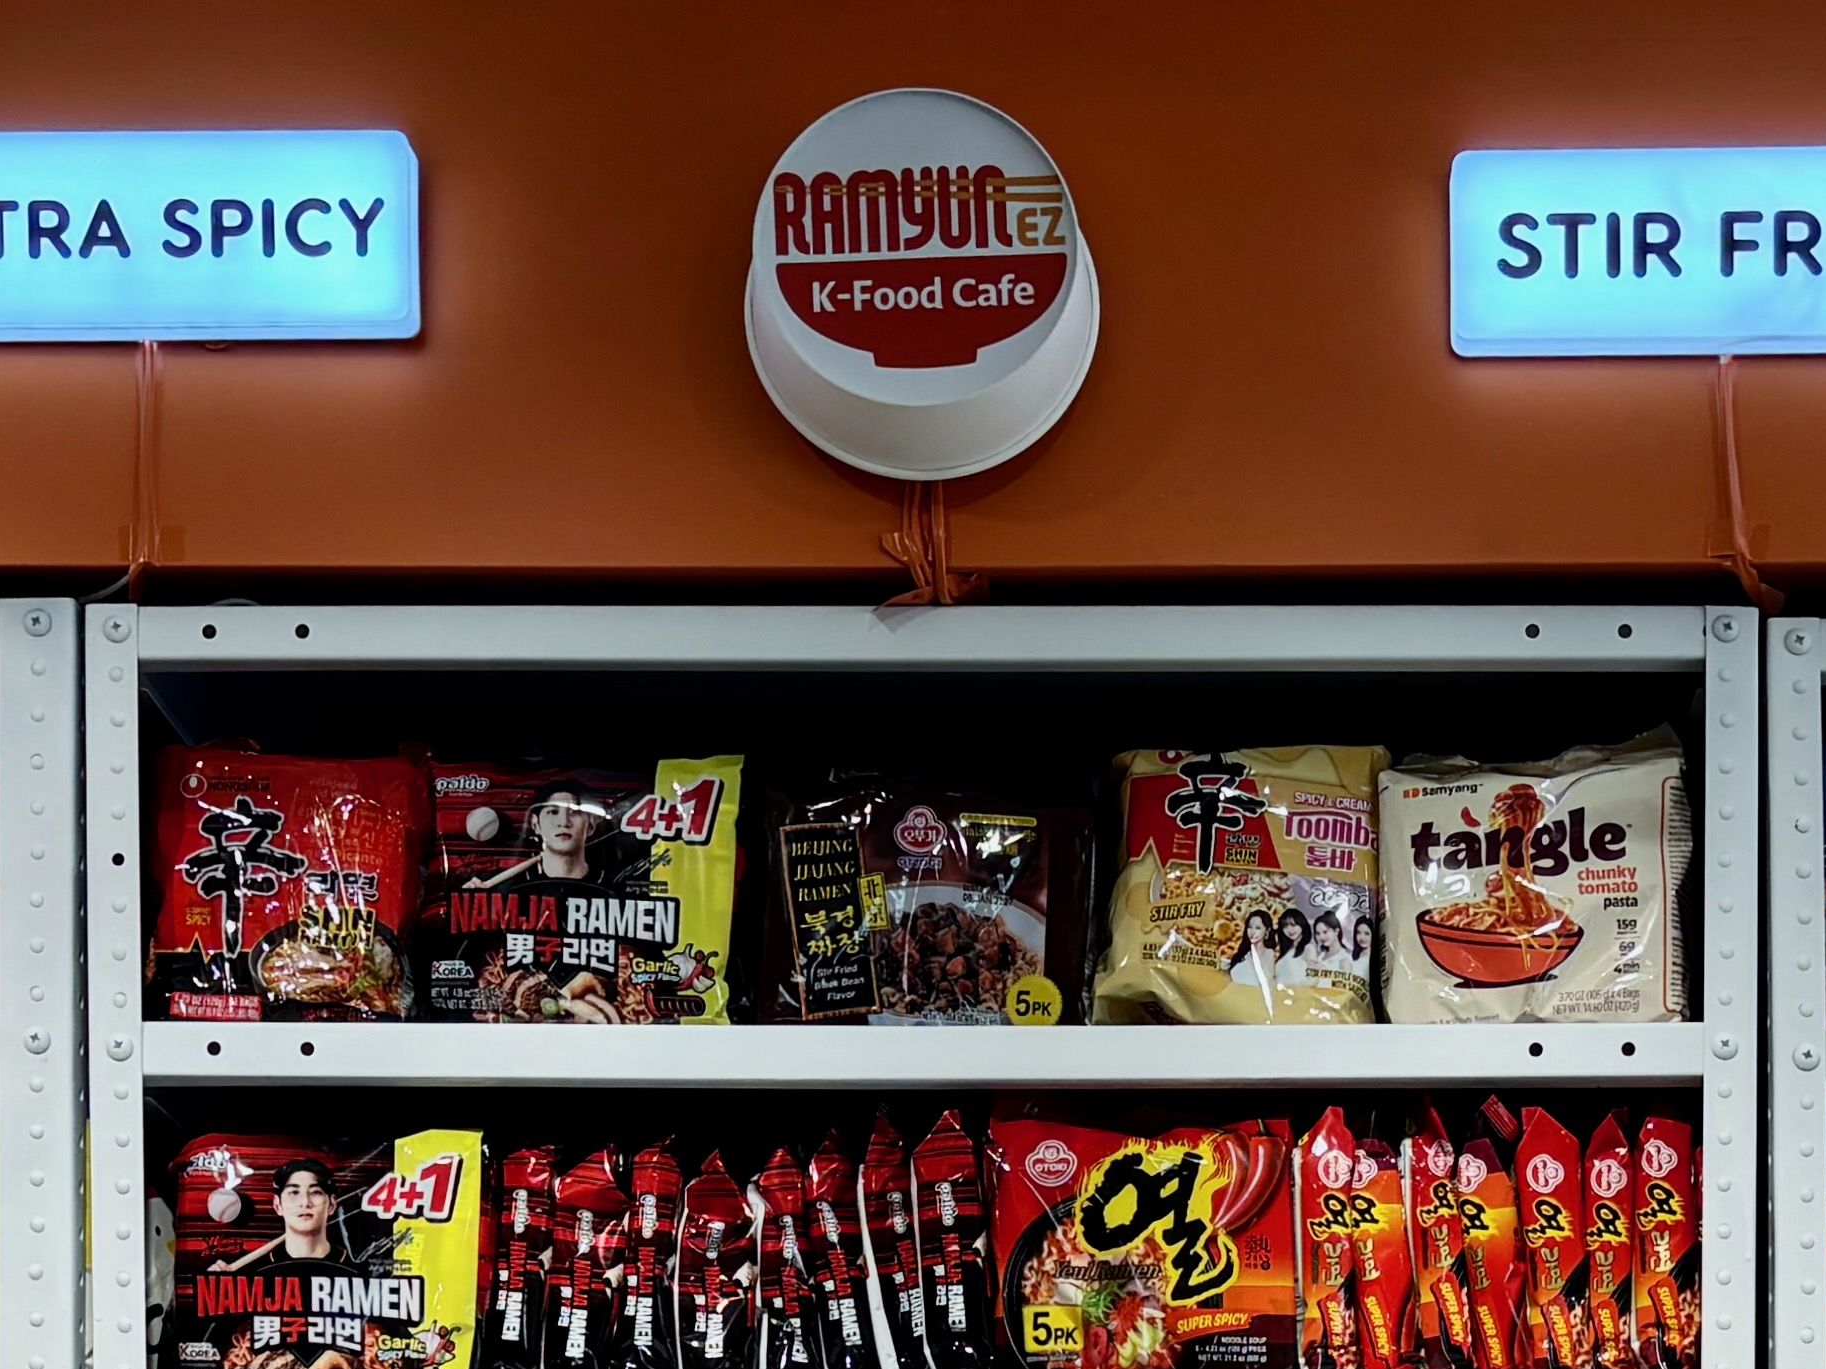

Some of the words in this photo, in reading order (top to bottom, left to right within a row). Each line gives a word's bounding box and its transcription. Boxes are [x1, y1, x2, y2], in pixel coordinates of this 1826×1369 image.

[159, 196, 388, 259] SPICY
[1016, 207, 1068, 249] EZ
[1491, 207, 1684, 283] STIR
[810, 277, 944, 314] K-Food
[950, 273, 1036, 307] Cafe
[621, 776, 722, 843] 4+1
[1422, 781, 1479, 800] Samyang
[1164, 751, 1268, 876] 辛
[1576, 864, 1637, 883] chunky
[1576, 878, 1640, 895] tomato
[449, 892, 559, 934] NAMJA
[566, 896, 676, 946] RAMEN
[1602, 894, 1640, 911] pasta
[505, 932, 616, 968] 男子라면
[630, 957, 678, 977] Garlic
[1176, 1314, 1219, 1333] SUPER
[1217, 1312, 1250, 1329] SPICY
